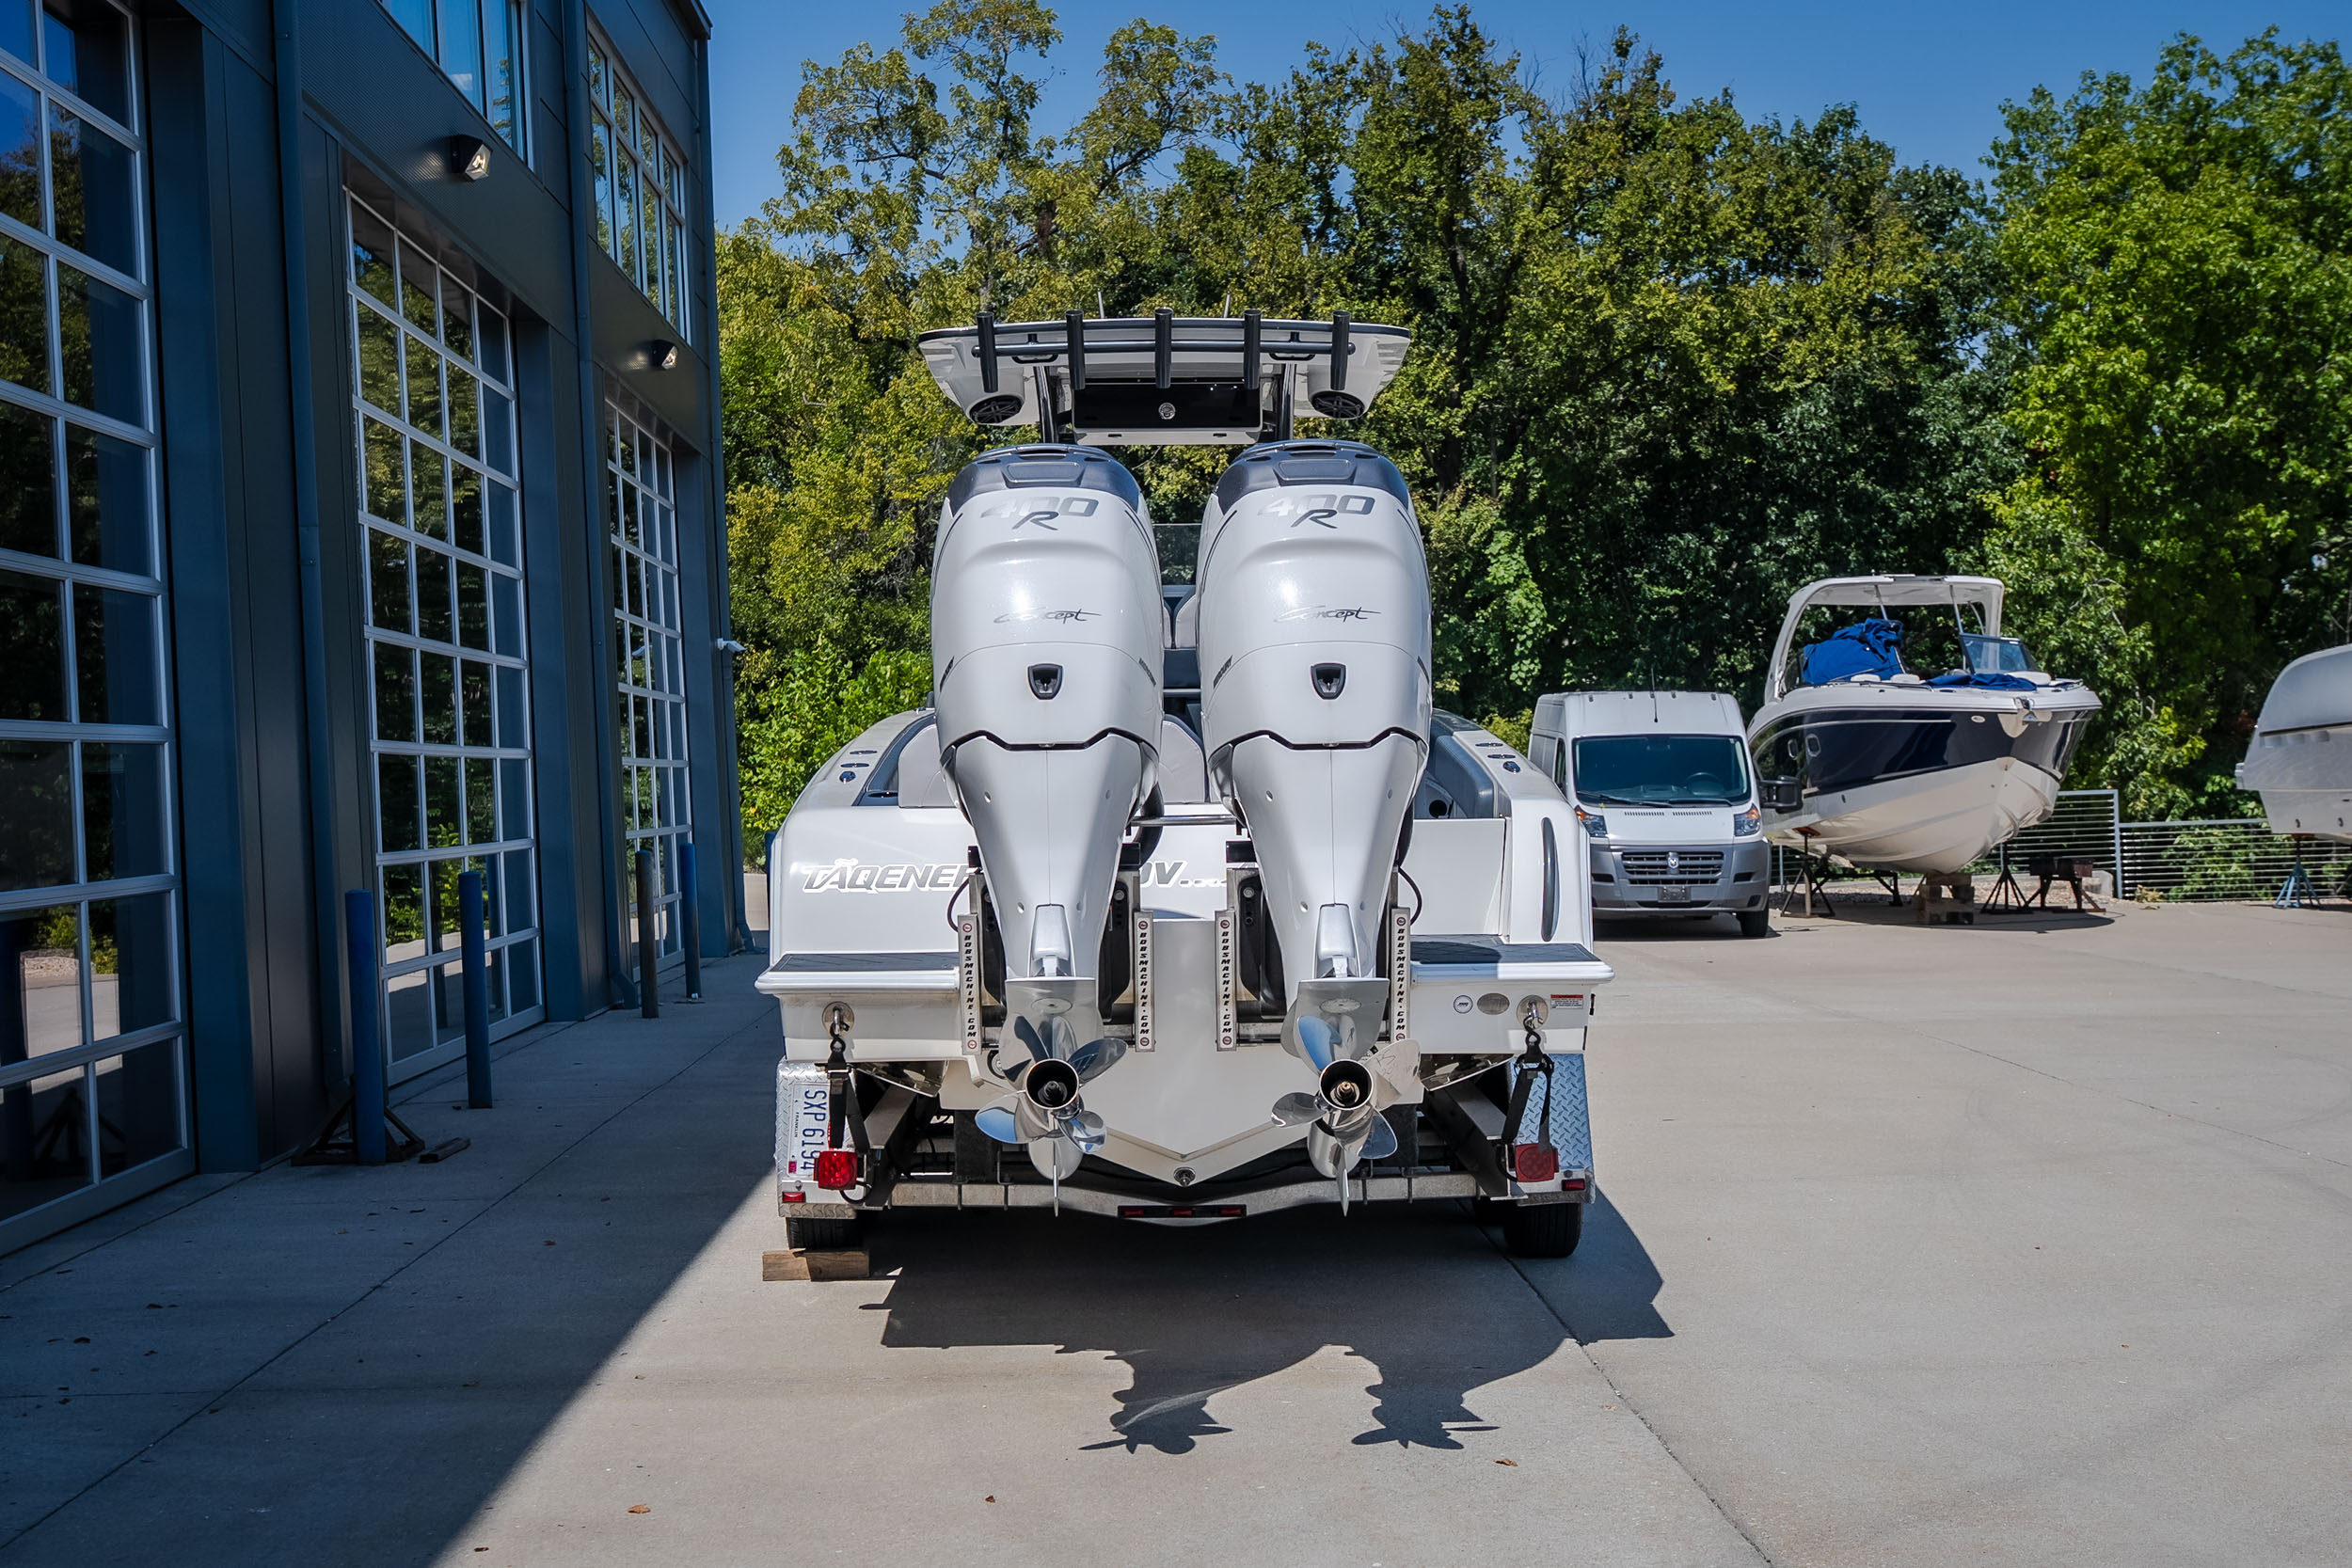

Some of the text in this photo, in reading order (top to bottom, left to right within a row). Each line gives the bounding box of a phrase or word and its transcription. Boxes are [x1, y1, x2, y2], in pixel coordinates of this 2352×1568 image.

[1257, 494, 1375, 516] 400
[1011, 510, 1059, 531] R
[1290, 508, 1338, 529] R
[800, 1089, 828, 1170] SXP 6194
